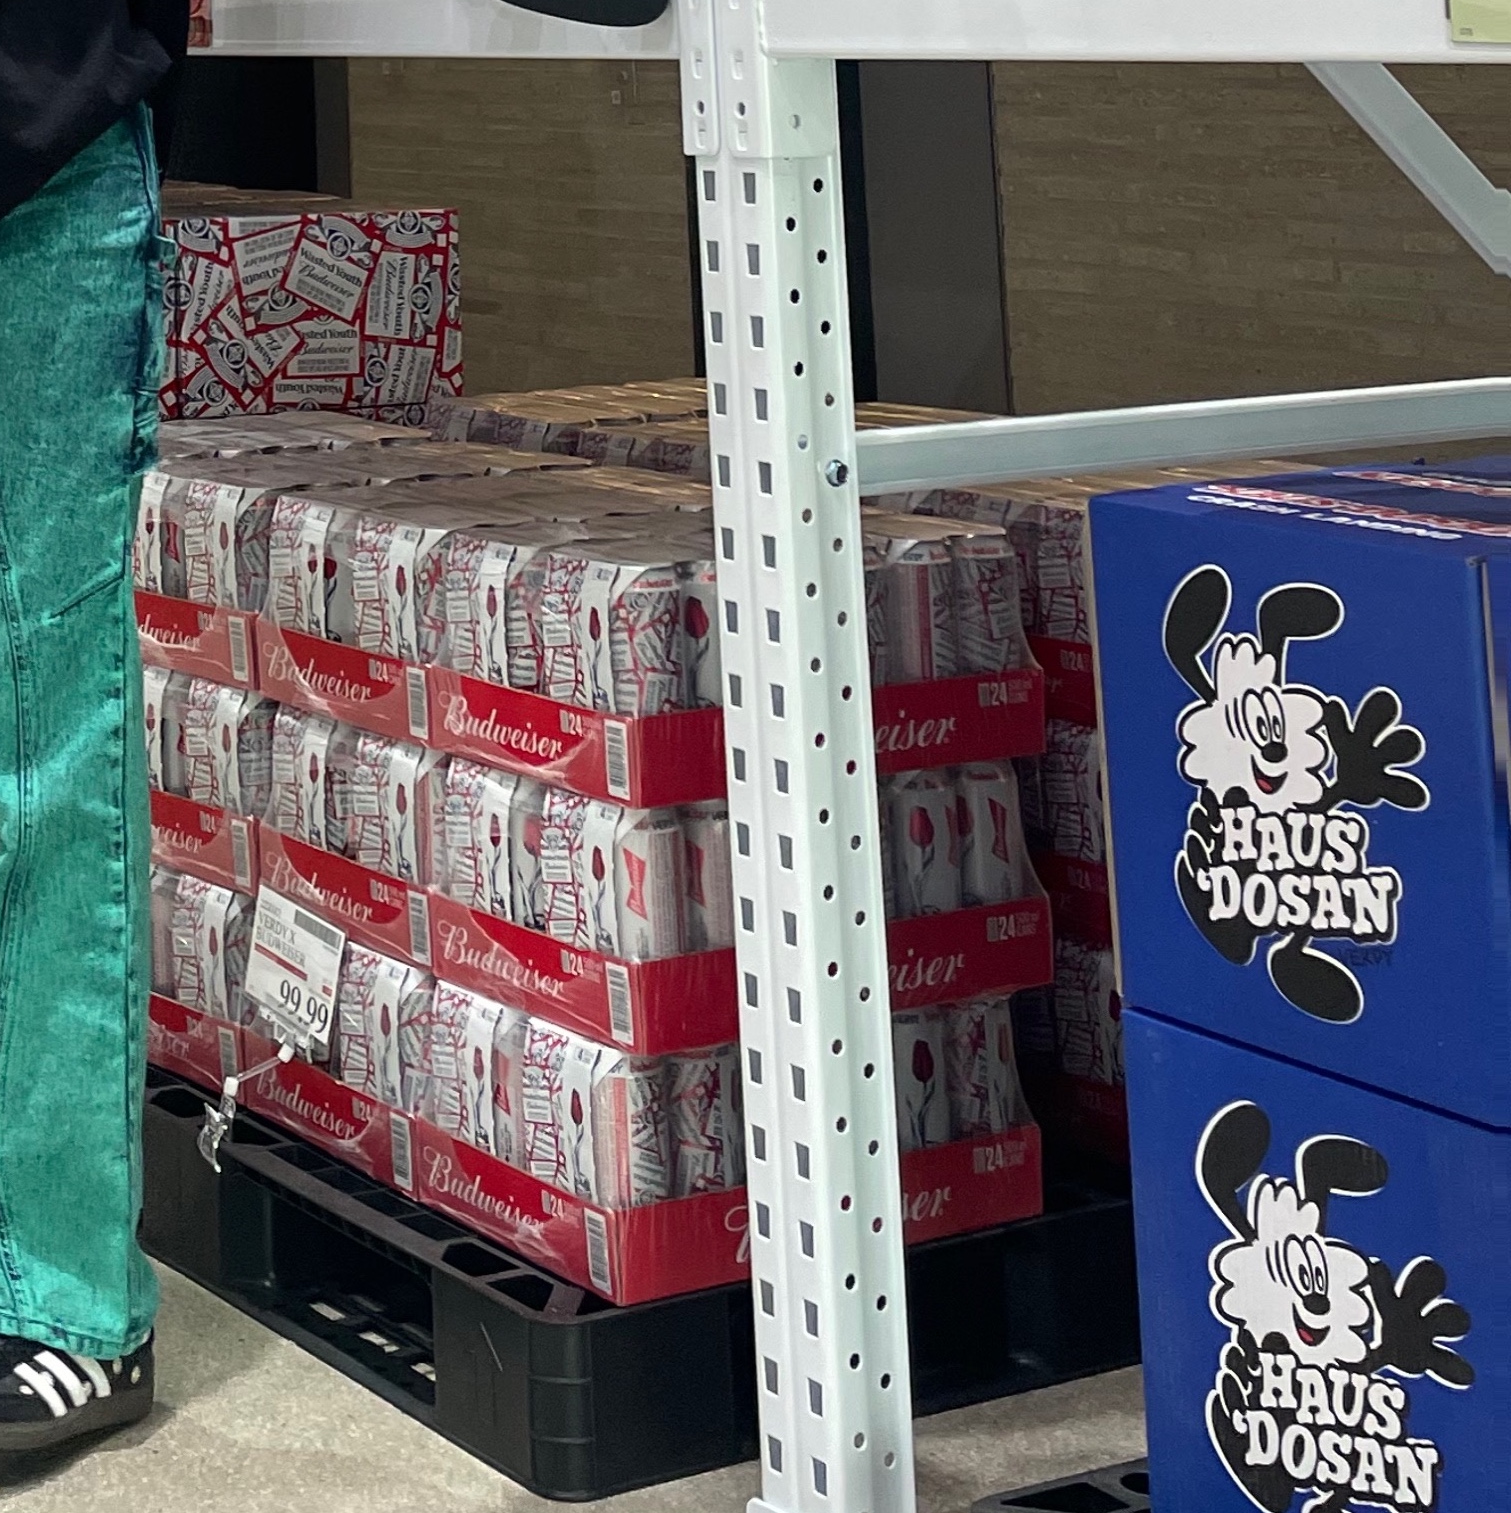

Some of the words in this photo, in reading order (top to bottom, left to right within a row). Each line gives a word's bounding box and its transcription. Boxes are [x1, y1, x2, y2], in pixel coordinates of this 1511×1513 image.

[263, 641, 372, 701] Budweiser
[377, 661, 391, 683] 24
[991, 682, 1008, 707] 24
[439, 690, 562, 761] Budweiser
[569, 714, 583, 736] 24
[1221, 806, 1362, 874] HAUS
[266, 851, 372, 923] Budweiser
[1199, 864, 1393, 934] DOSAN
[256, 926, 306, 967] BUDWEISER
[259, 911, 287, 938] VERDY
[999, 914, 1016, 940] 24
[438, 920, 564, 998] Budweiser
[570, 952, 583, 976] 24
[280, 980, 328, 1033] 99.99
[252, 1058, 355, 1138] Budweiser
[424, 1146, 544, 1230] Budweiser
[551, 1195, 564, 1219] 24
[1258, 1352, 1405, 1441] HAUS
[1236, 1410, 1439, 1507] DOSAN
